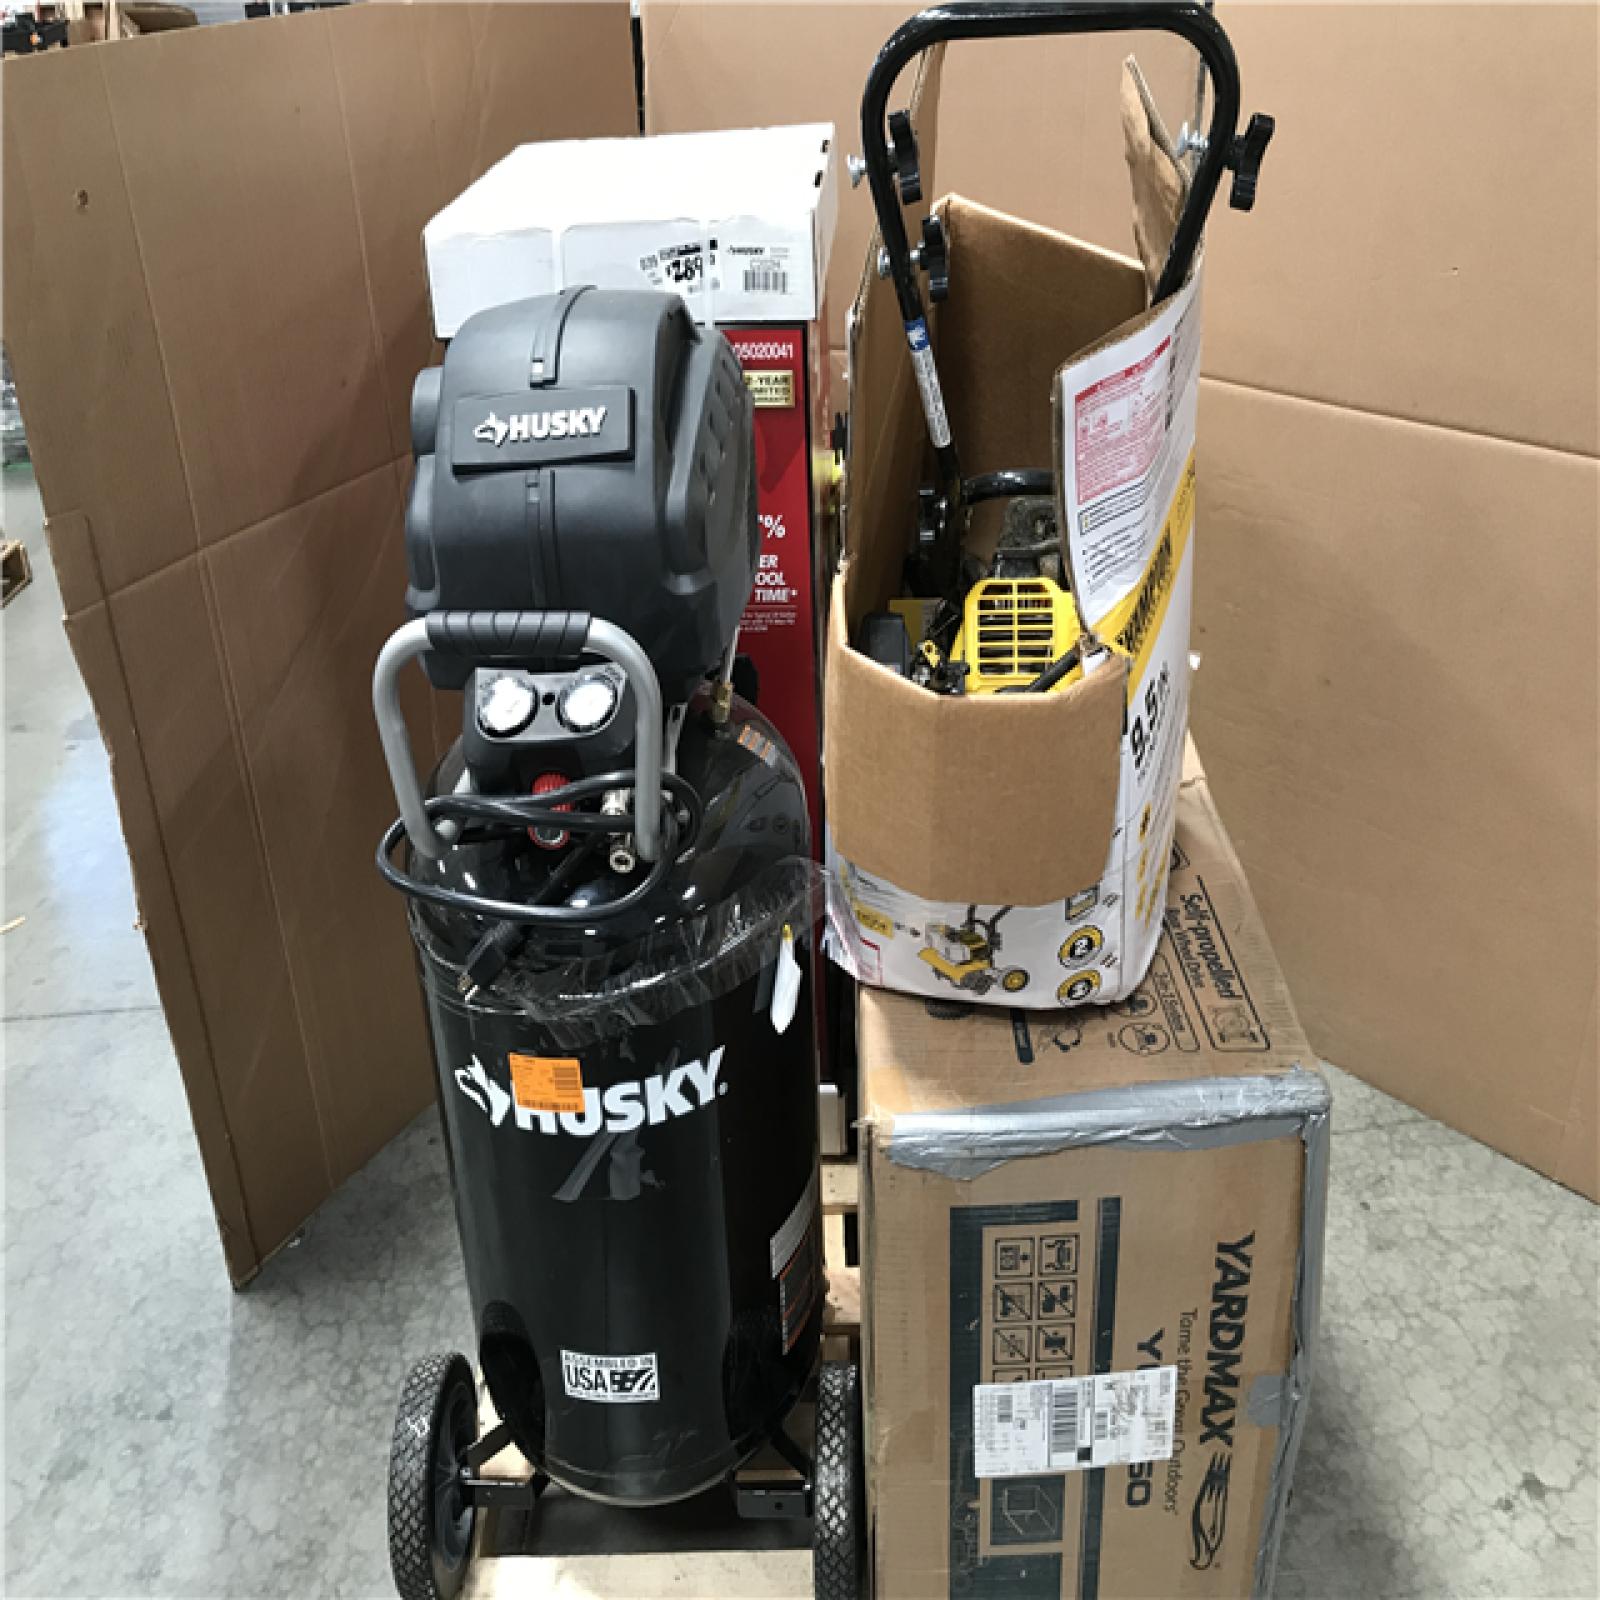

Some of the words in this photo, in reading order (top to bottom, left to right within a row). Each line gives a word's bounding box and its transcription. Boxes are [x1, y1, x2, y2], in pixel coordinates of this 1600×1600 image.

[509, 406, 608, 443] HUSKY
[1180, 893, 1243, 999] Self-propelled
[1177, 1308, 1198, 1356] Tame
[1199, 1230, 1256, 1448] YARDMAX
[565, 1364, 608, 1392] USA
[1176, 1358, 1194, 1386] the
